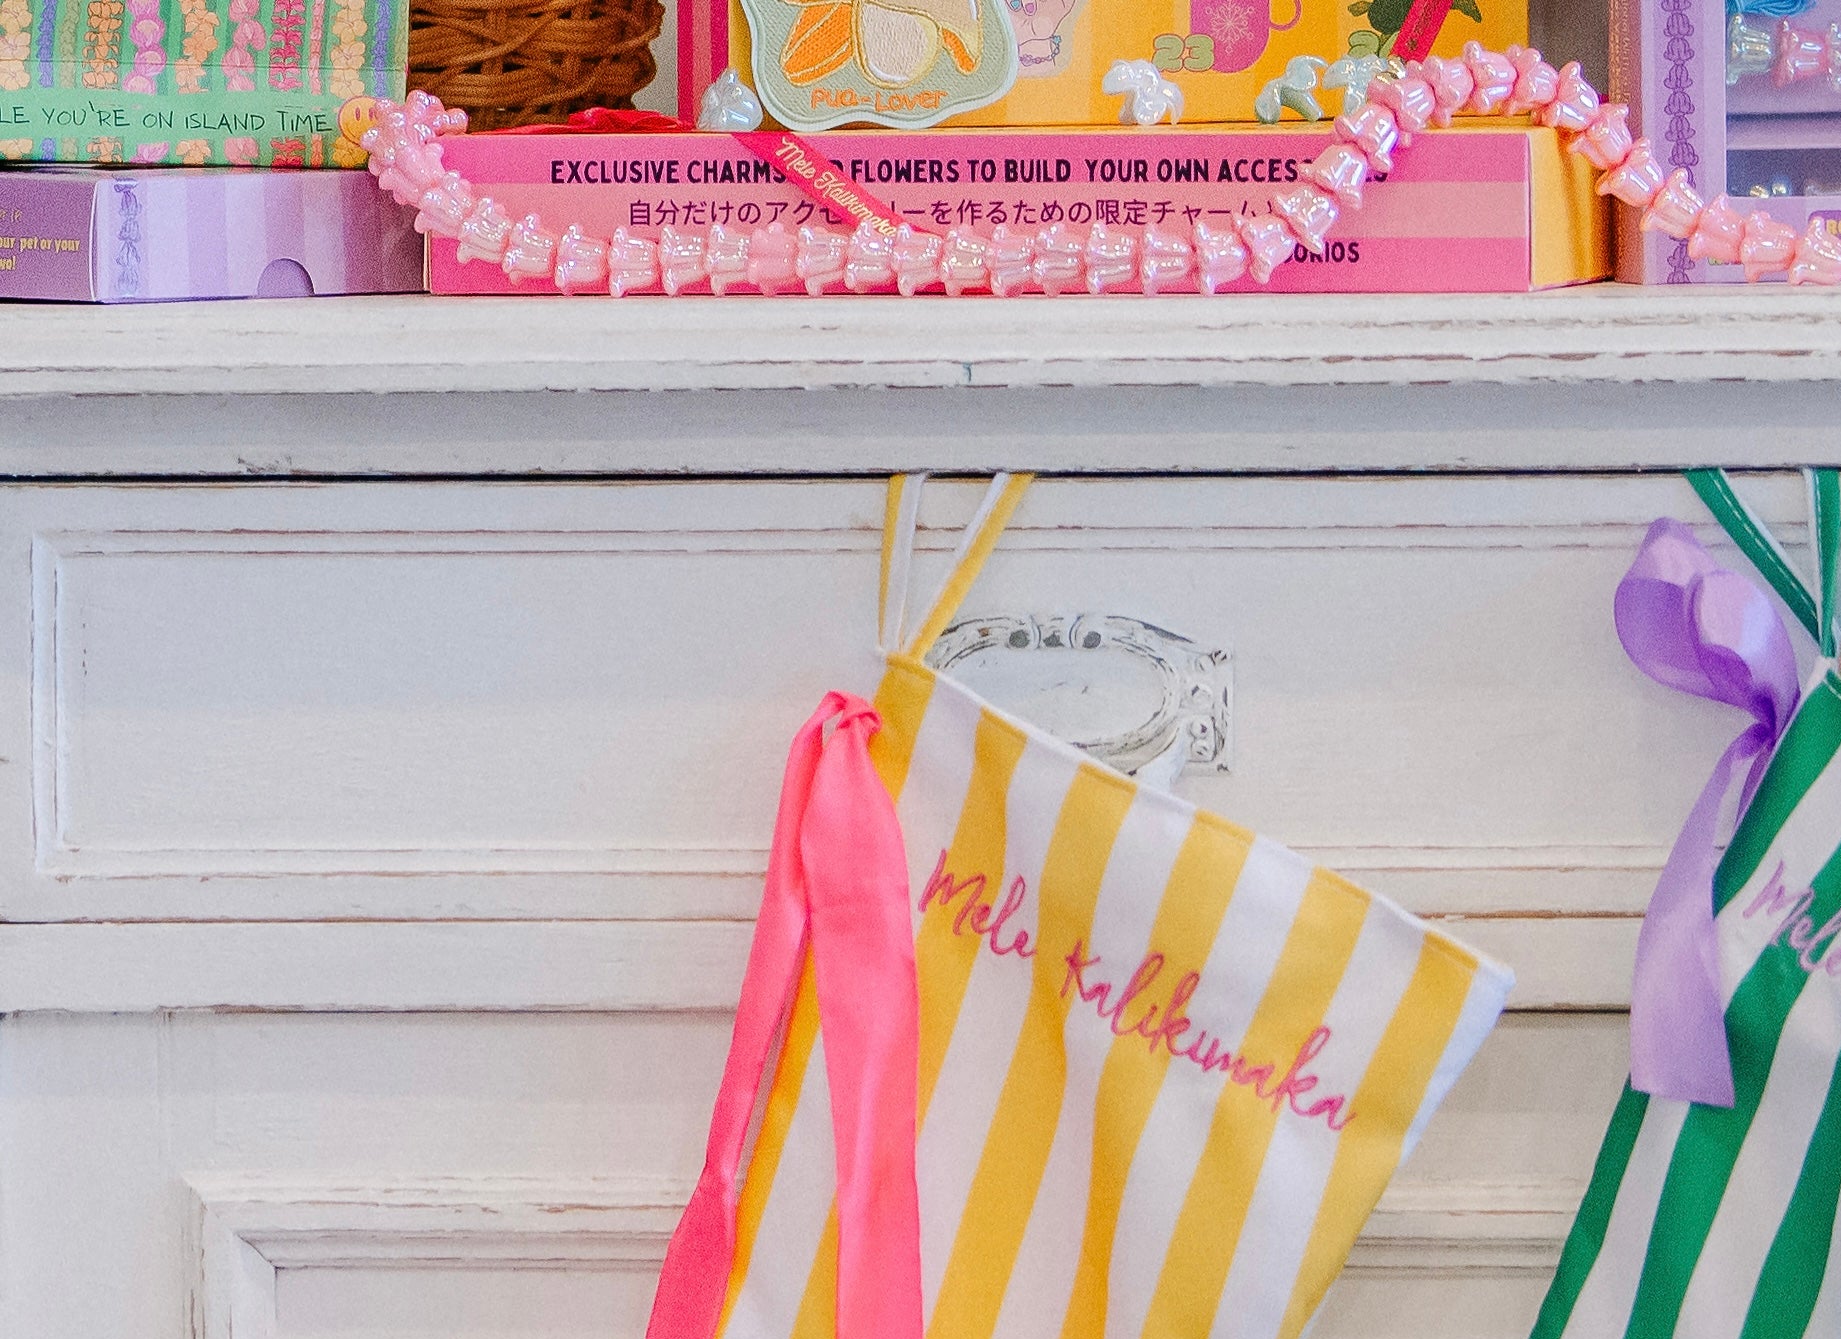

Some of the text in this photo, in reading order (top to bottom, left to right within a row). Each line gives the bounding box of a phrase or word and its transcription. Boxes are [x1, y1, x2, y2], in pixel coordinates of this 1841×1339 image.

[1151, 33, 1215, 72] 23
[42, 101, 130, 127] YOU'RE
[143, 111, 173, 129] ON
[551, 160, 680, 184] EXCLUSIVE
[687, 160, 786, 184] CHARMS
[851, 159, 959, 183] FLOWERS
[967, 159, 996, 183] TO
[1004, 159, 1071, 183] BUILD
[1085, 159, 1149, 183] YOUR
[1157, 159, 1210, 183] OWN
[776, 137, 816, 179] Mele
[54, 239, 80, 253] your
[919, 849, 1358, 1132] Mele Kalikimaka
